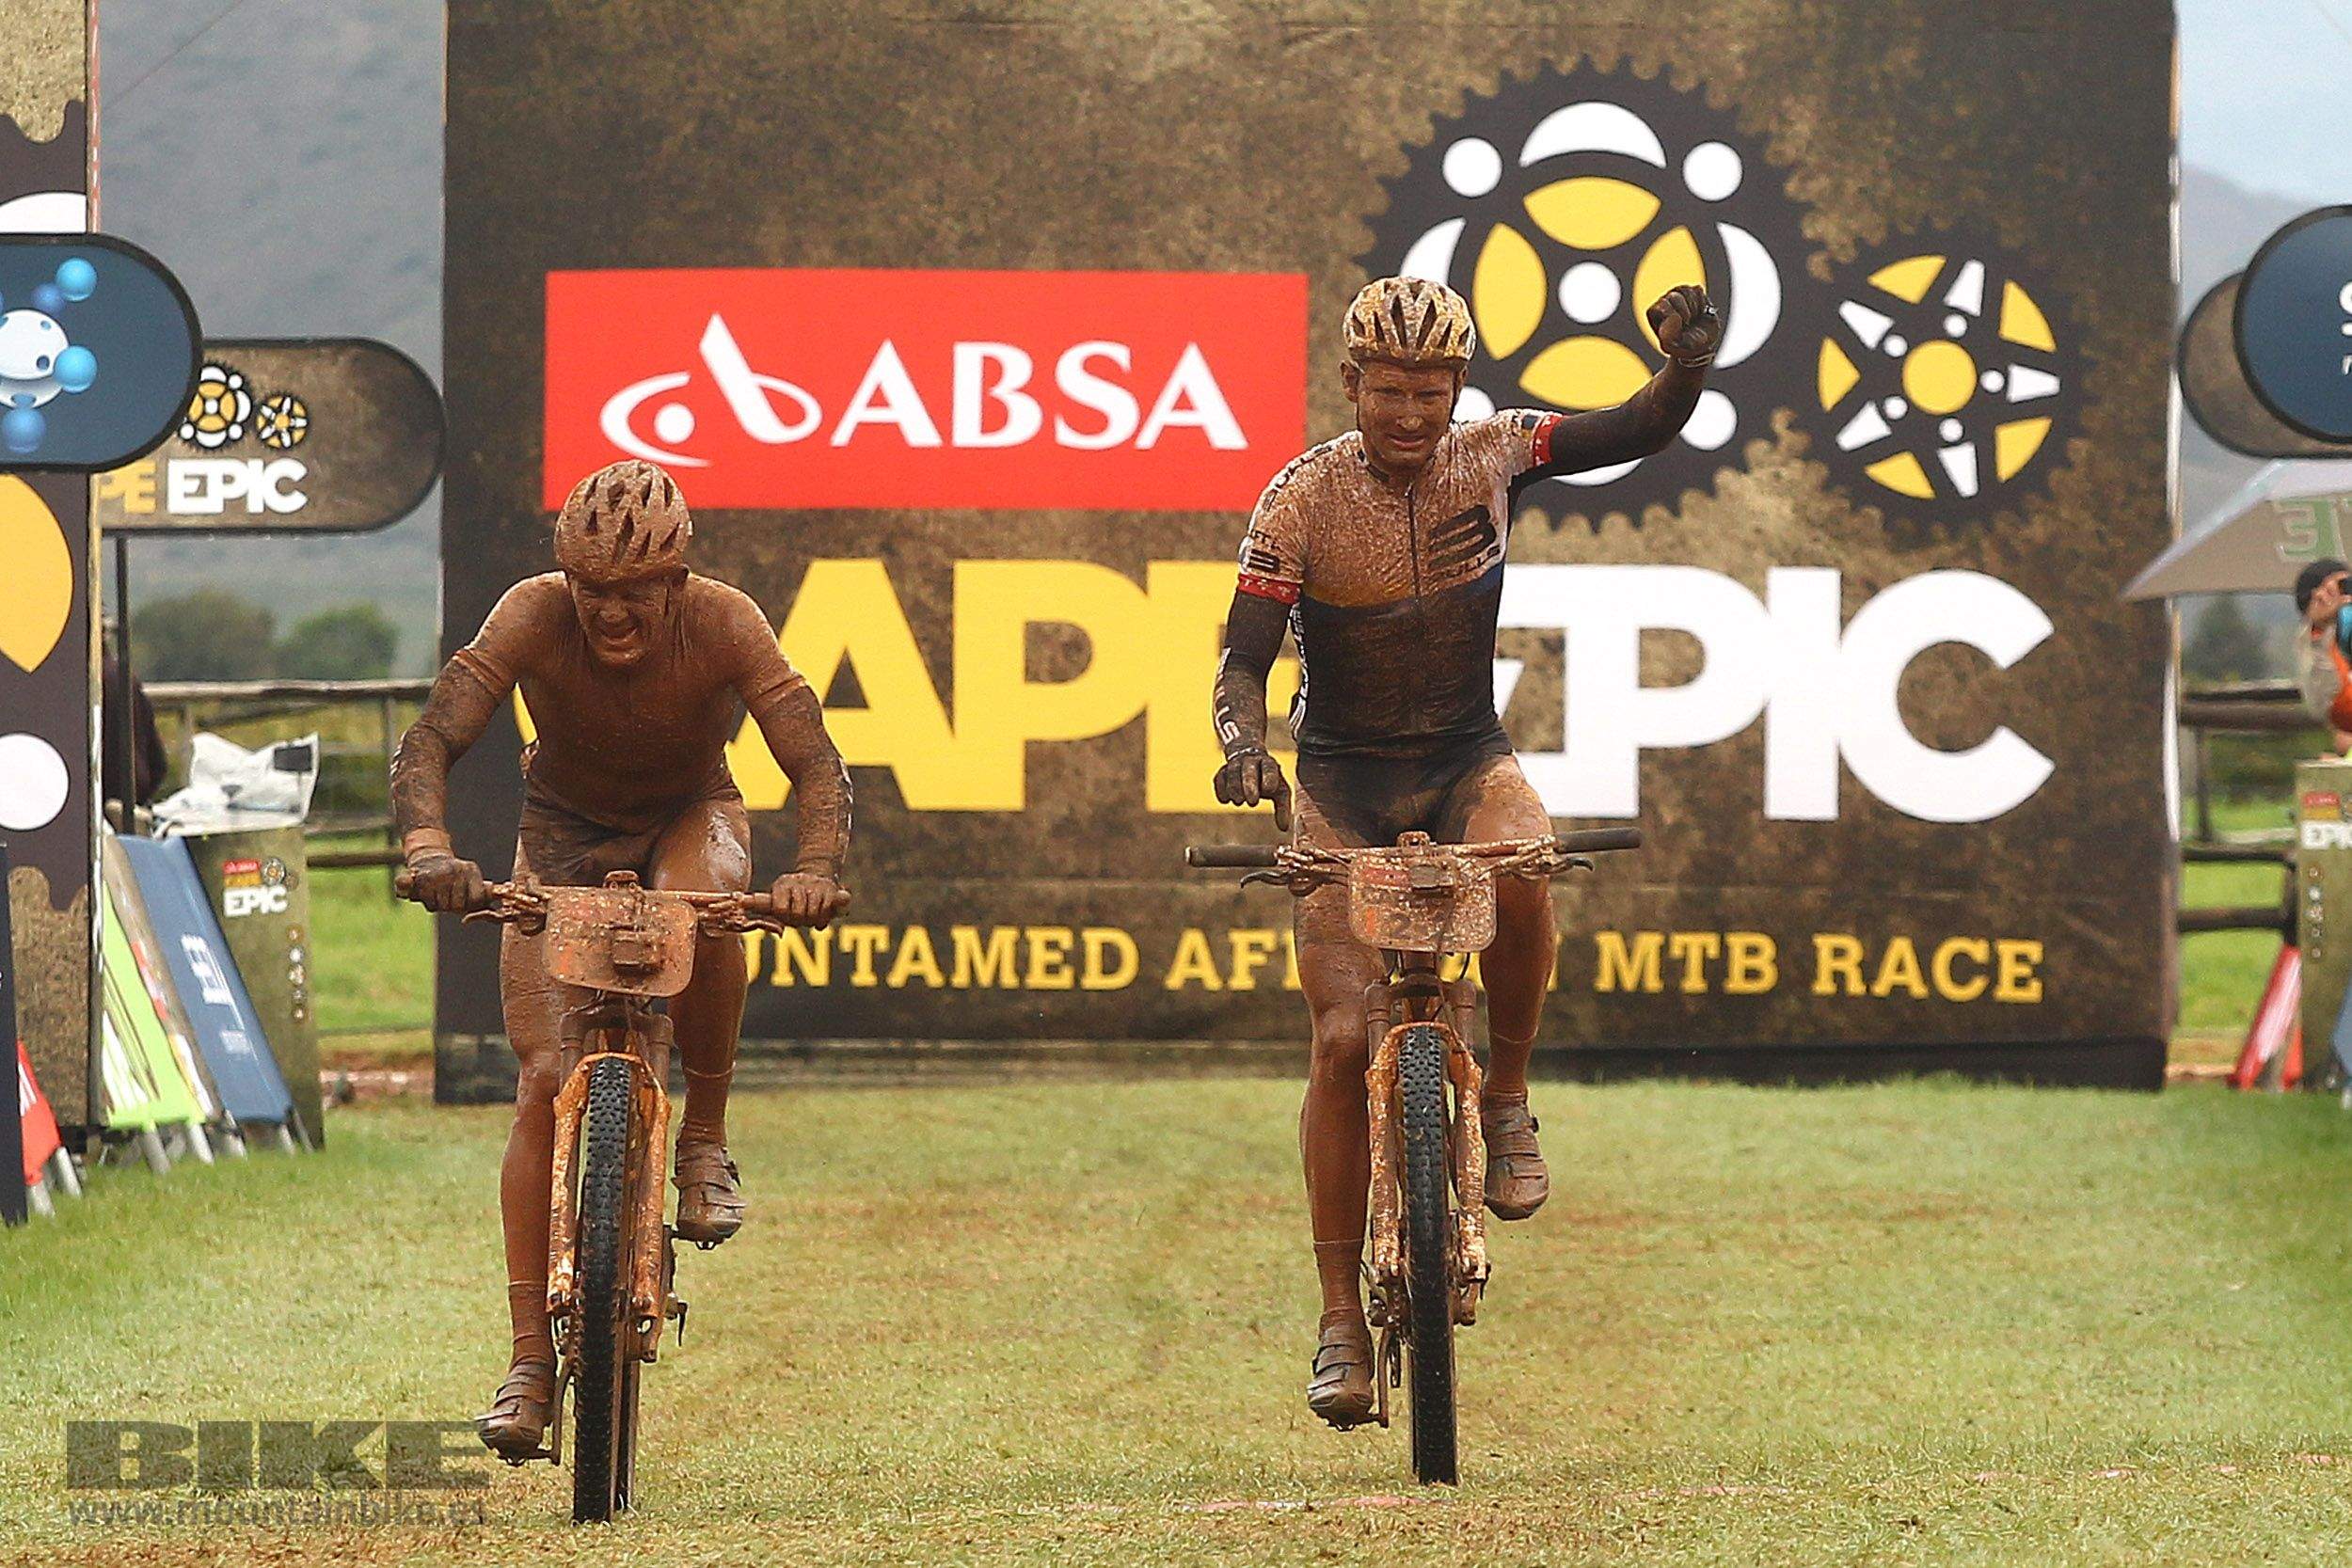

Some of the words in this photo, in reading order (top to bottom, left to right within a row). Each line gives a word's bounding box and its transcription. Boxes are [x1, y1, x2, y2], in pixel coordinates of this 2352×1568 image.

[830, 338, 1249, 450] ABSA
[167, 458, 308, 514] EPIC
[513, 559, 1302, 812] APE
[224, 885, 288, 917] EPIC
[1596, 930, 1779, 995] MTB
[1812, 932, 2045, 1003] RACE
